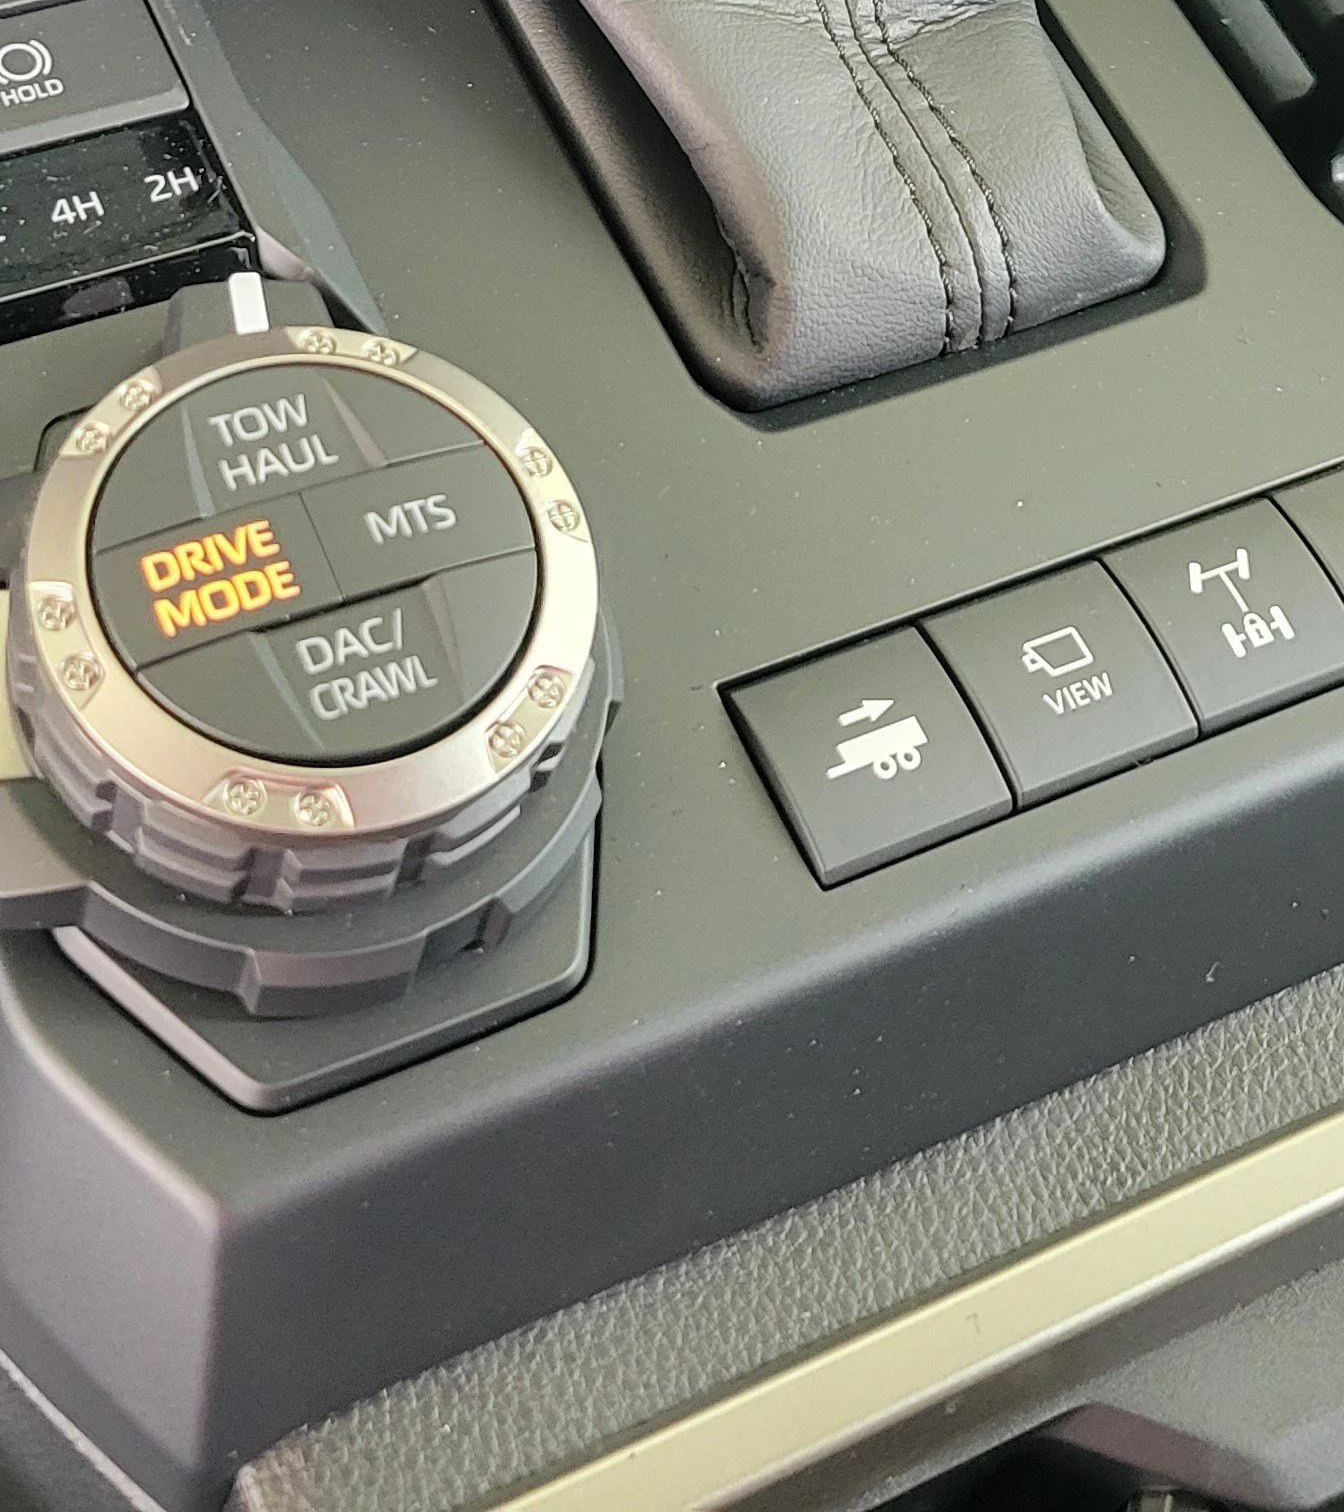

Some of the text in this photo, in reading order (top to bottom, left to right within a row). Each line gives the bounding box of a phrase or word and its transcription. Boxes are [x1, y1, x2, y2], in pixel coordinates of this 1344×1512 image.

[0, 78, 64, 107] HOLD
[51, 191, 105, 224] 4H
[144, 166, 199, 202] 2H
[208, 393, 308, 448] TOW
[217, 434, 340, 492] HAUL
[363, 494, 457, 545] MTS
[141, 519, 281, 593] DRIVE
[153, 560, 302, 638] MODE
[295, 607, 404, 675] DAC/
[308, 654, 440, 722] CRAWL
[1042, 671, 1113, 715] VIEW
